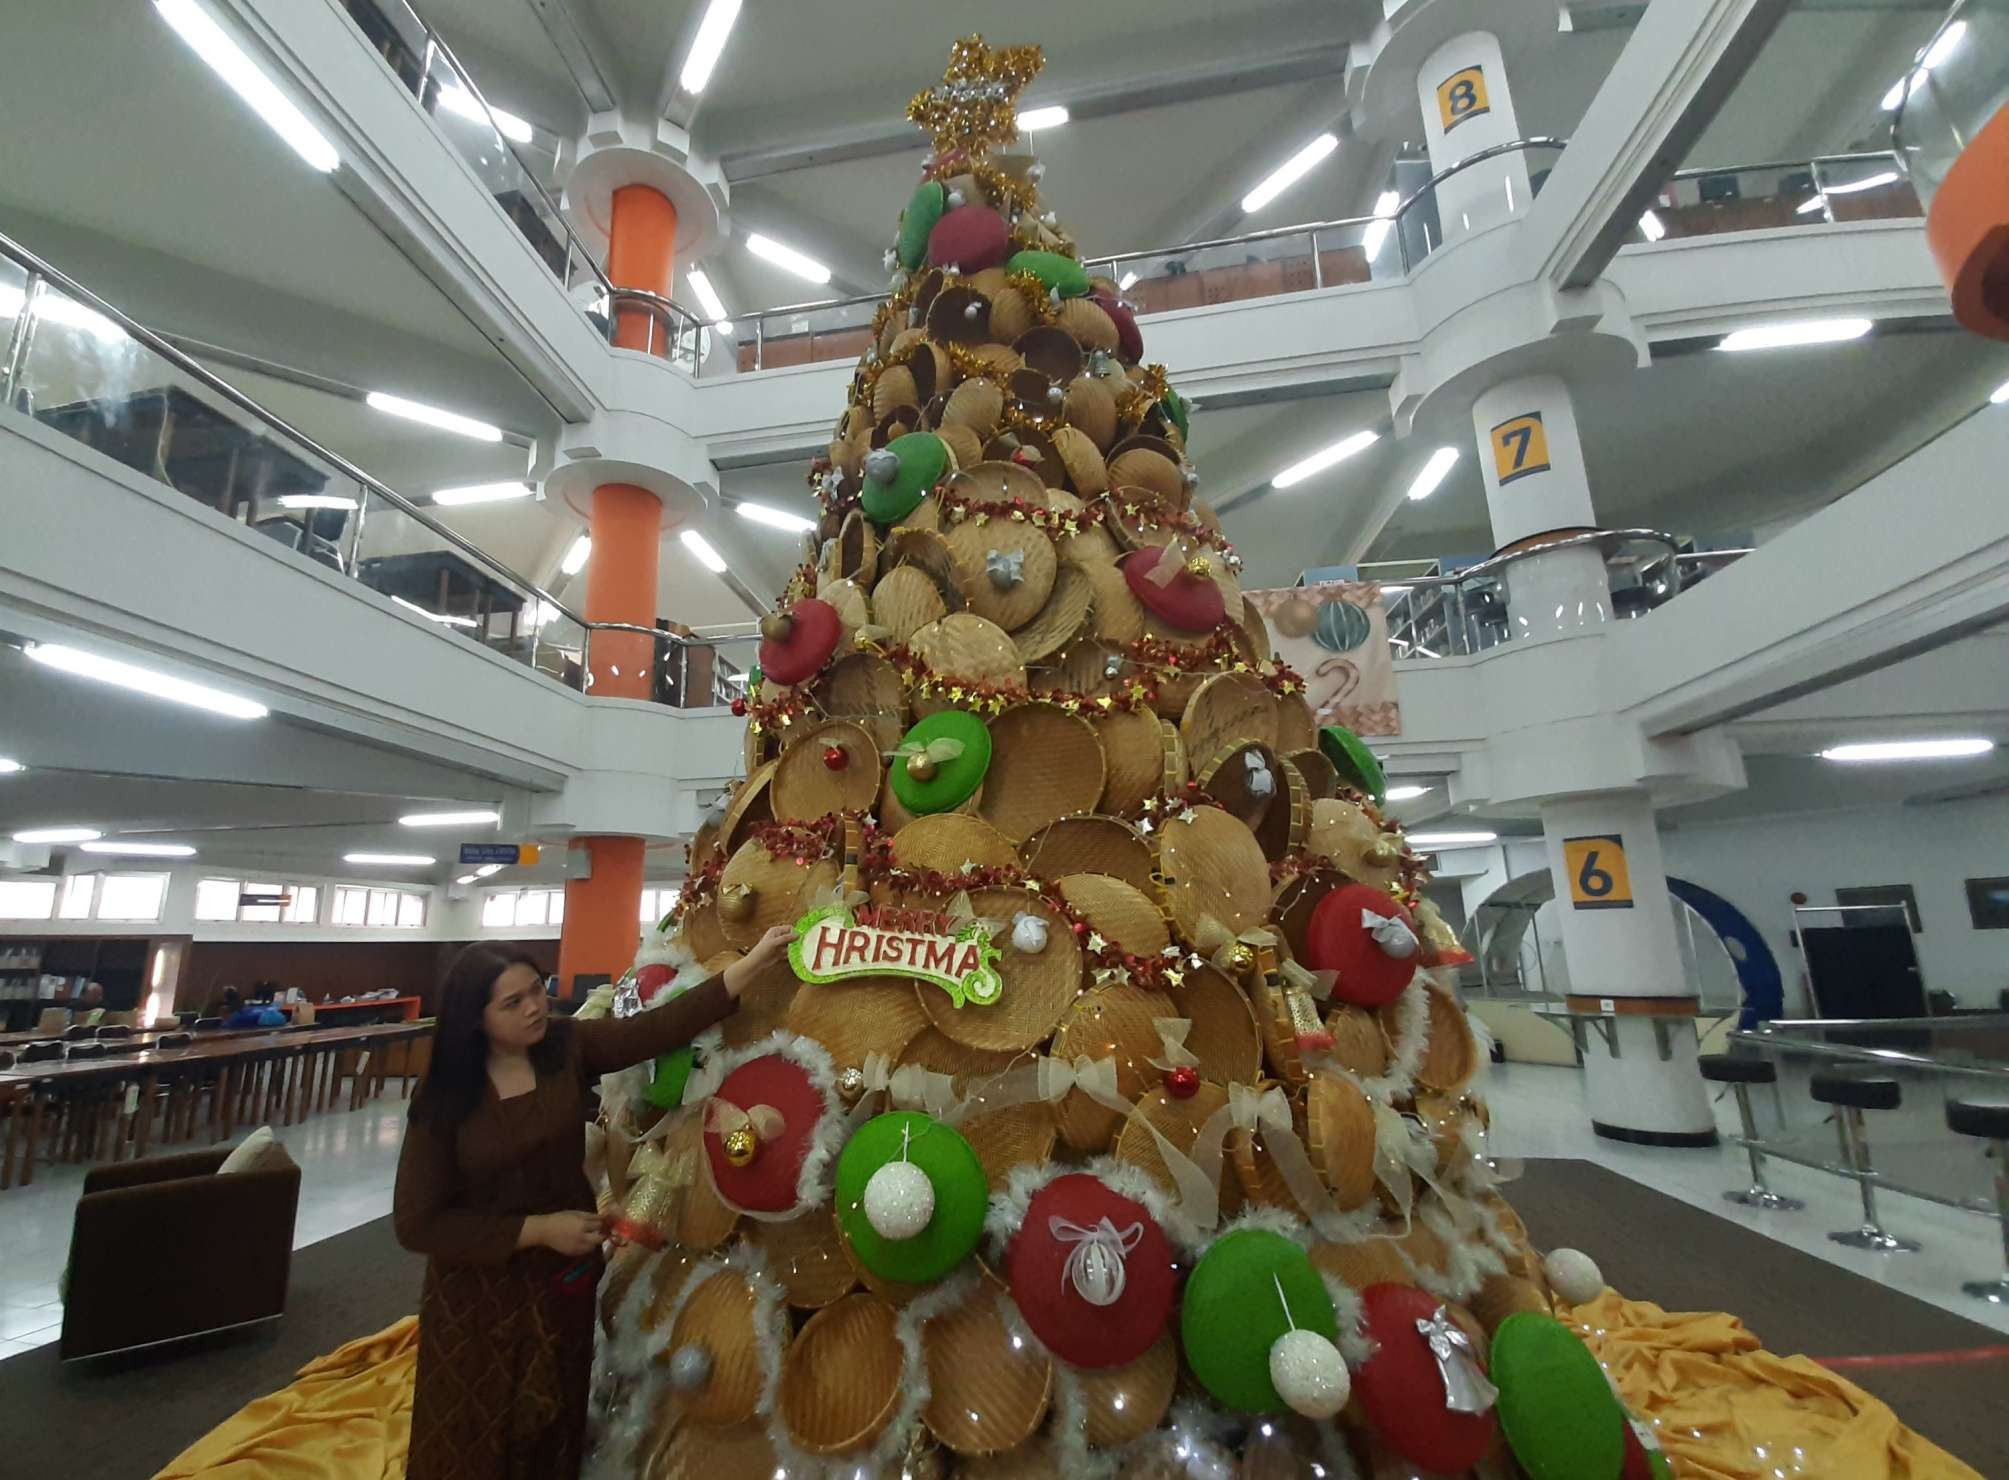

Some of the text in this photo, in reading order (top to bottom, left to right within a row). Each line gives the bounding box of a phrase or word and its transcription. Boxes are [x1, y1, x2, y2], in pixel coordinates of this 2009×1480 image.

[1449, 80, 1477, 115] 8
[1502, 426, 1532, 470] 7
[1579, 851, 1613, 897] 6
[854, 903, 959, 938] MERRY
